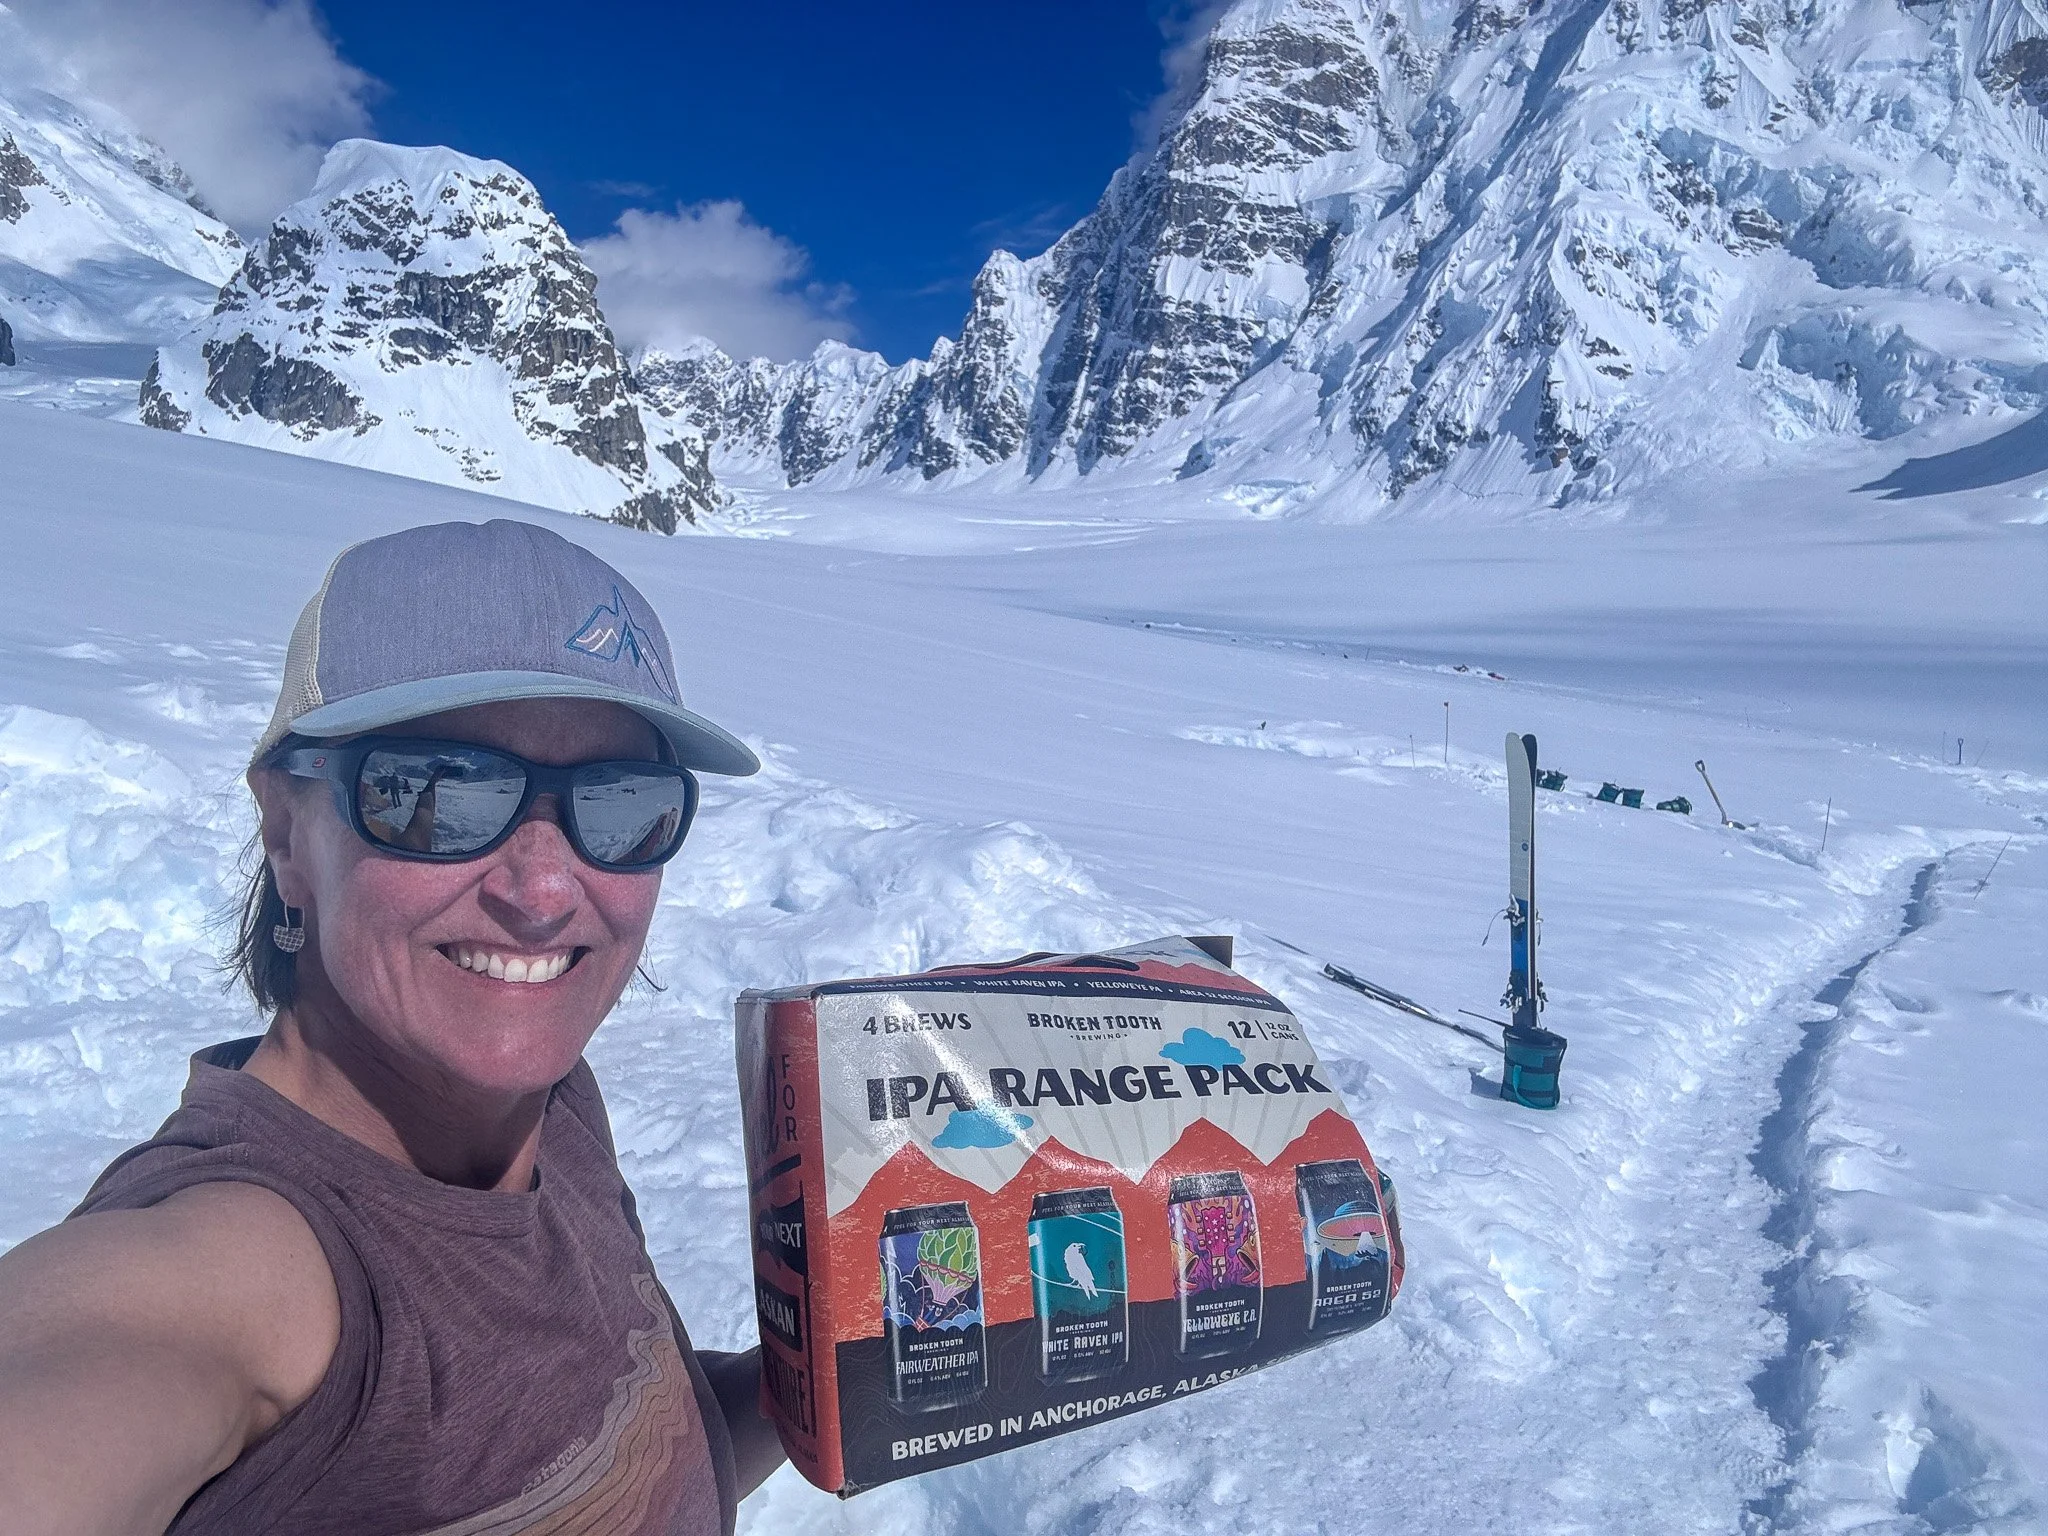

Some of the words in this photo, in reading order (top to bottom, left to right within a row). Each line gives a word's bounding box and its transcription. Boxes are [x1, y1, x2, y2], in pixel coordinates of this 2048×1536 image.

[1011, 979, 1046, 988] RAVEN
[1047, 980, 1066, 988] IPA
[1086, 981, 1148, 991] YELLOWEYE
[863, 1016, 878, 1035] 4
[884, 1013, 972, 1034] BREWS
[1027, 1013, 1102, 1031] BROKEN
[1103, 1015, 1162, 1031] TOOTH
[1227, 1020, 1257, 1039] 12
[1265, 1022, 1277, 1030] 12
[1277, 1023, 1292, 1032] OZ
[1075, 1033, 1121, 1041] BREWING
[1271, 1031, 1300, 1041] CANS
[866, 1071, 978, 1122] IPA
[988, 1064, 1182, 1108] RANGE
[1184, 1062, 1333, 1098] PACK
[774, 1222, 803, 1249] NEXT
[1327, 1284, 1352, 1293] BROKEN
[1352, 1281, 1372, 1289] TOOTH
[1196, 1303, 1223, 1312] BROKEN
[1224, 1299, 1245, 1308] TOOTH
[1313, 1293, 1357, 1308] AREA
[1361, 1288, 1381, 1300] 52
[758, 1288, 796, 1337] ASKAN
[1055, 1323, 1084, 1333] BROKEN
[1085, 1320, 1109, 1330] TOOTH
[909, 1341, 939, 1352] BROKEN
[940, 1338, 964, 1348] TOOTH
[1042, 1338, 1069, 1353] WHITE
[1073, 1334, 1108, 1349] RAVEN
[1111, 1331, 1124, 1345] IPA
[895, 1353, 965, 1376] FAIRWEATHER
[966, 1350, 979, 1365] IPA
[891, 1422, 994, 1461] BREWED
[1000, 1416, 1022, 1437] IN
[1029, 1384, 1167, 1428] ANCHORAGE,
[1172, 1364, 1259, 1395] ALASKA
